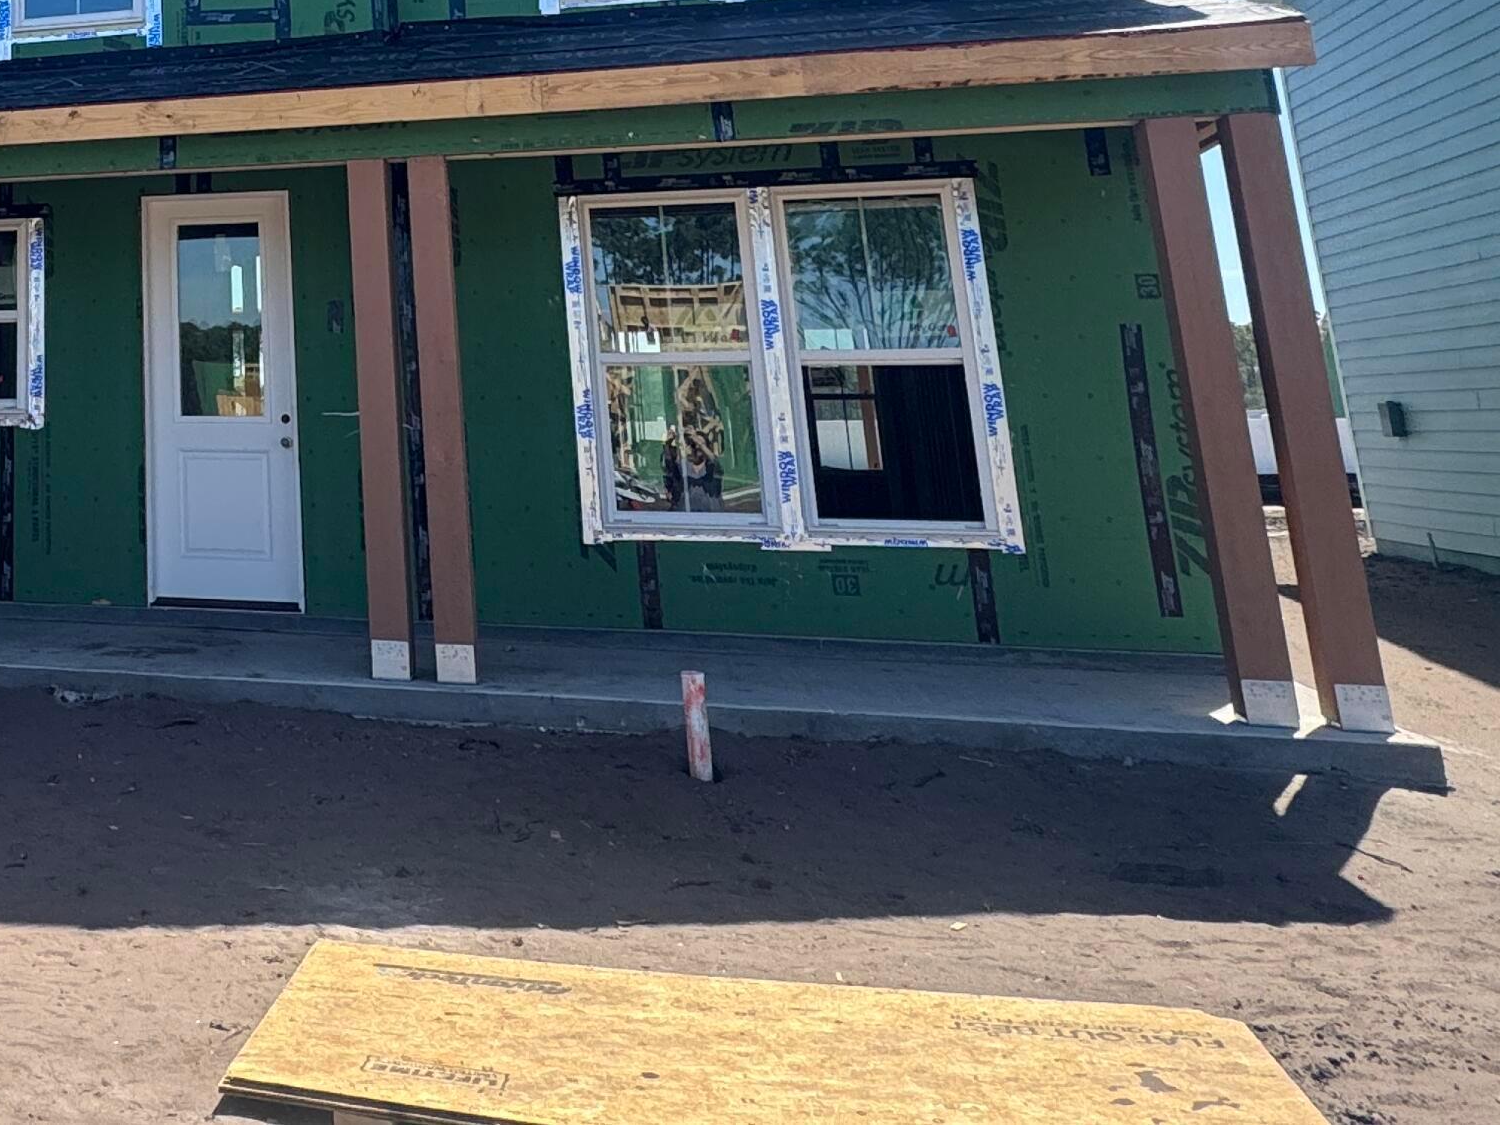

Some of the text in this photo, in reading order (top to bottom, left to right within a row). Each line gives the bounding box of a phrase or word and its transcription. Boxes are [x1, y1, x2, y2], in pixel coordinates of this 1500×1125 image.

[960, 229, 976, 281] WINDOW
[1135, 274, 1161, 299] 30
[761, 299, 775, 350] WINDOW
[983, 382, 997, 437] WINDOW
[778, 450, 791, 503] WINDOW
[786, 451, 798, 486] WRAP
[831, 573, 860, 596] 30
[949, 1021, 1041, 1036] BEST
[1048, 1027, 1126, 1042] OUT
[1137, 1034, 1225, 1050] FLAT
